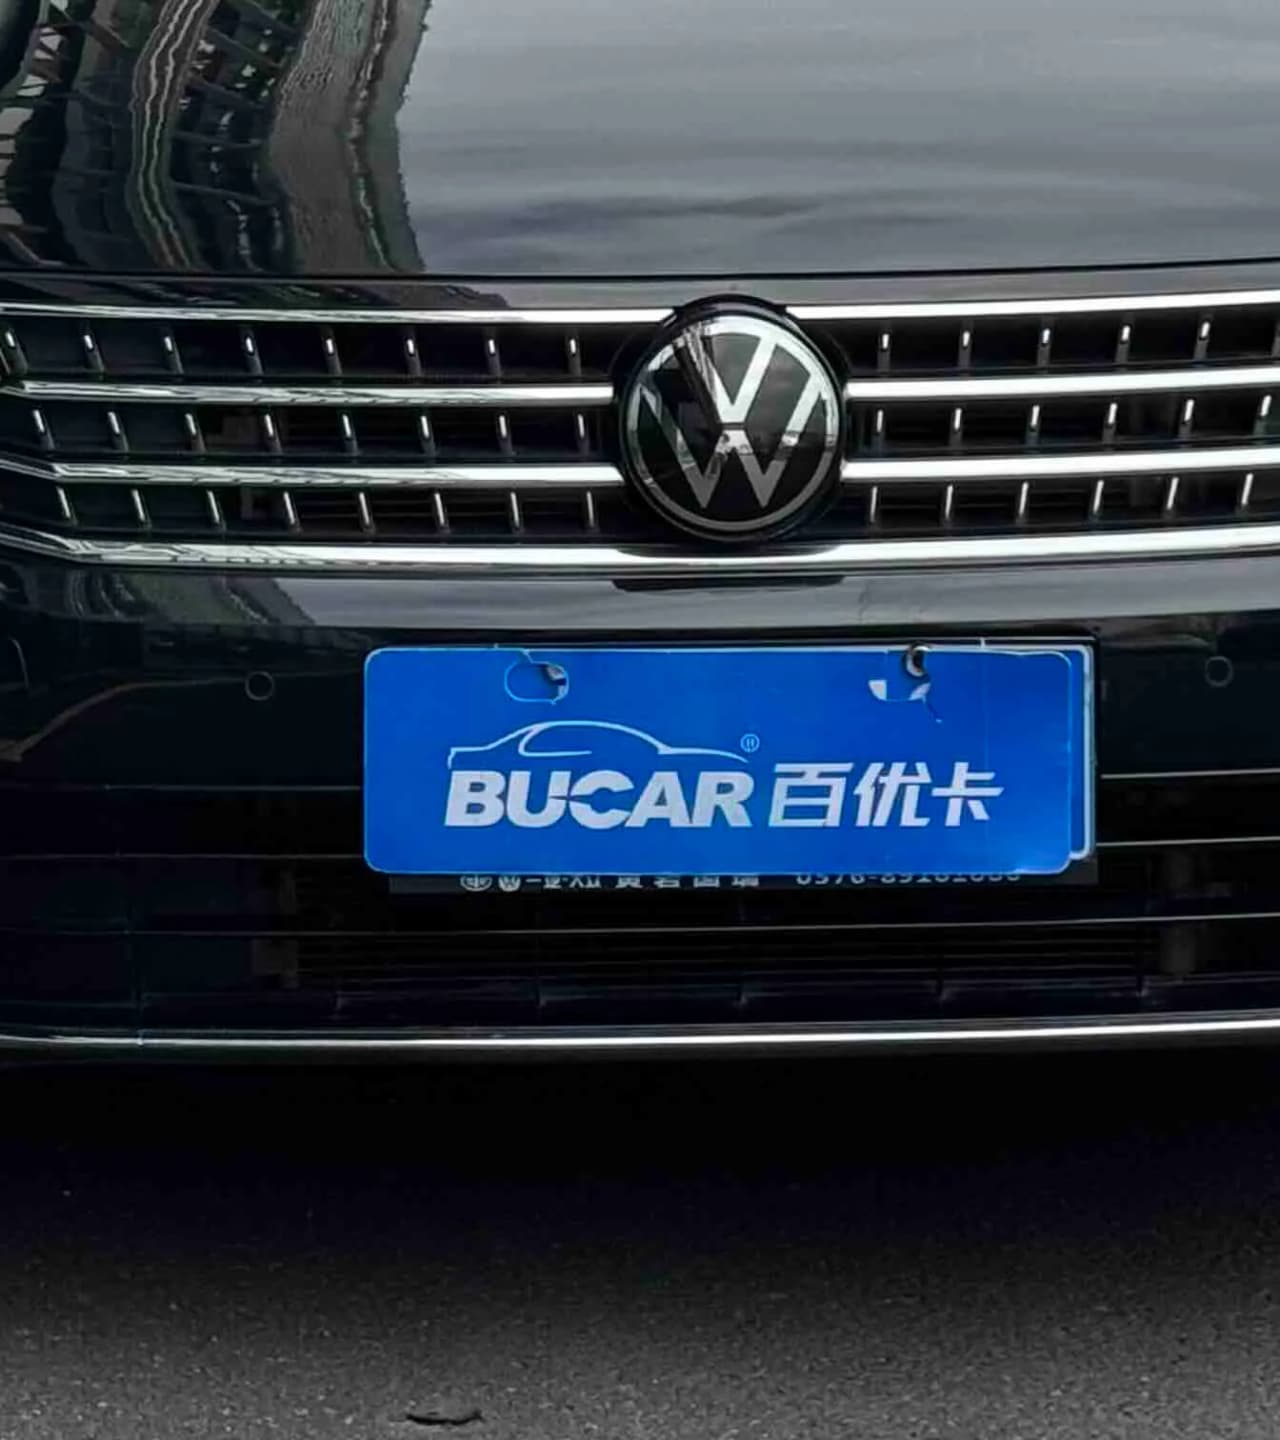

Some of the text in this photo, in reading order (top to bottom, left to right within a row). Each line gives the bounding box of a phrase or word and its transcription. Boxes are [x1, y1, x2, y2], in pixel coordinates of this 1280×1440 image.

[443, 768, 755, 829] BUCAR
[767, 761, 1005, 828] 百优卡
